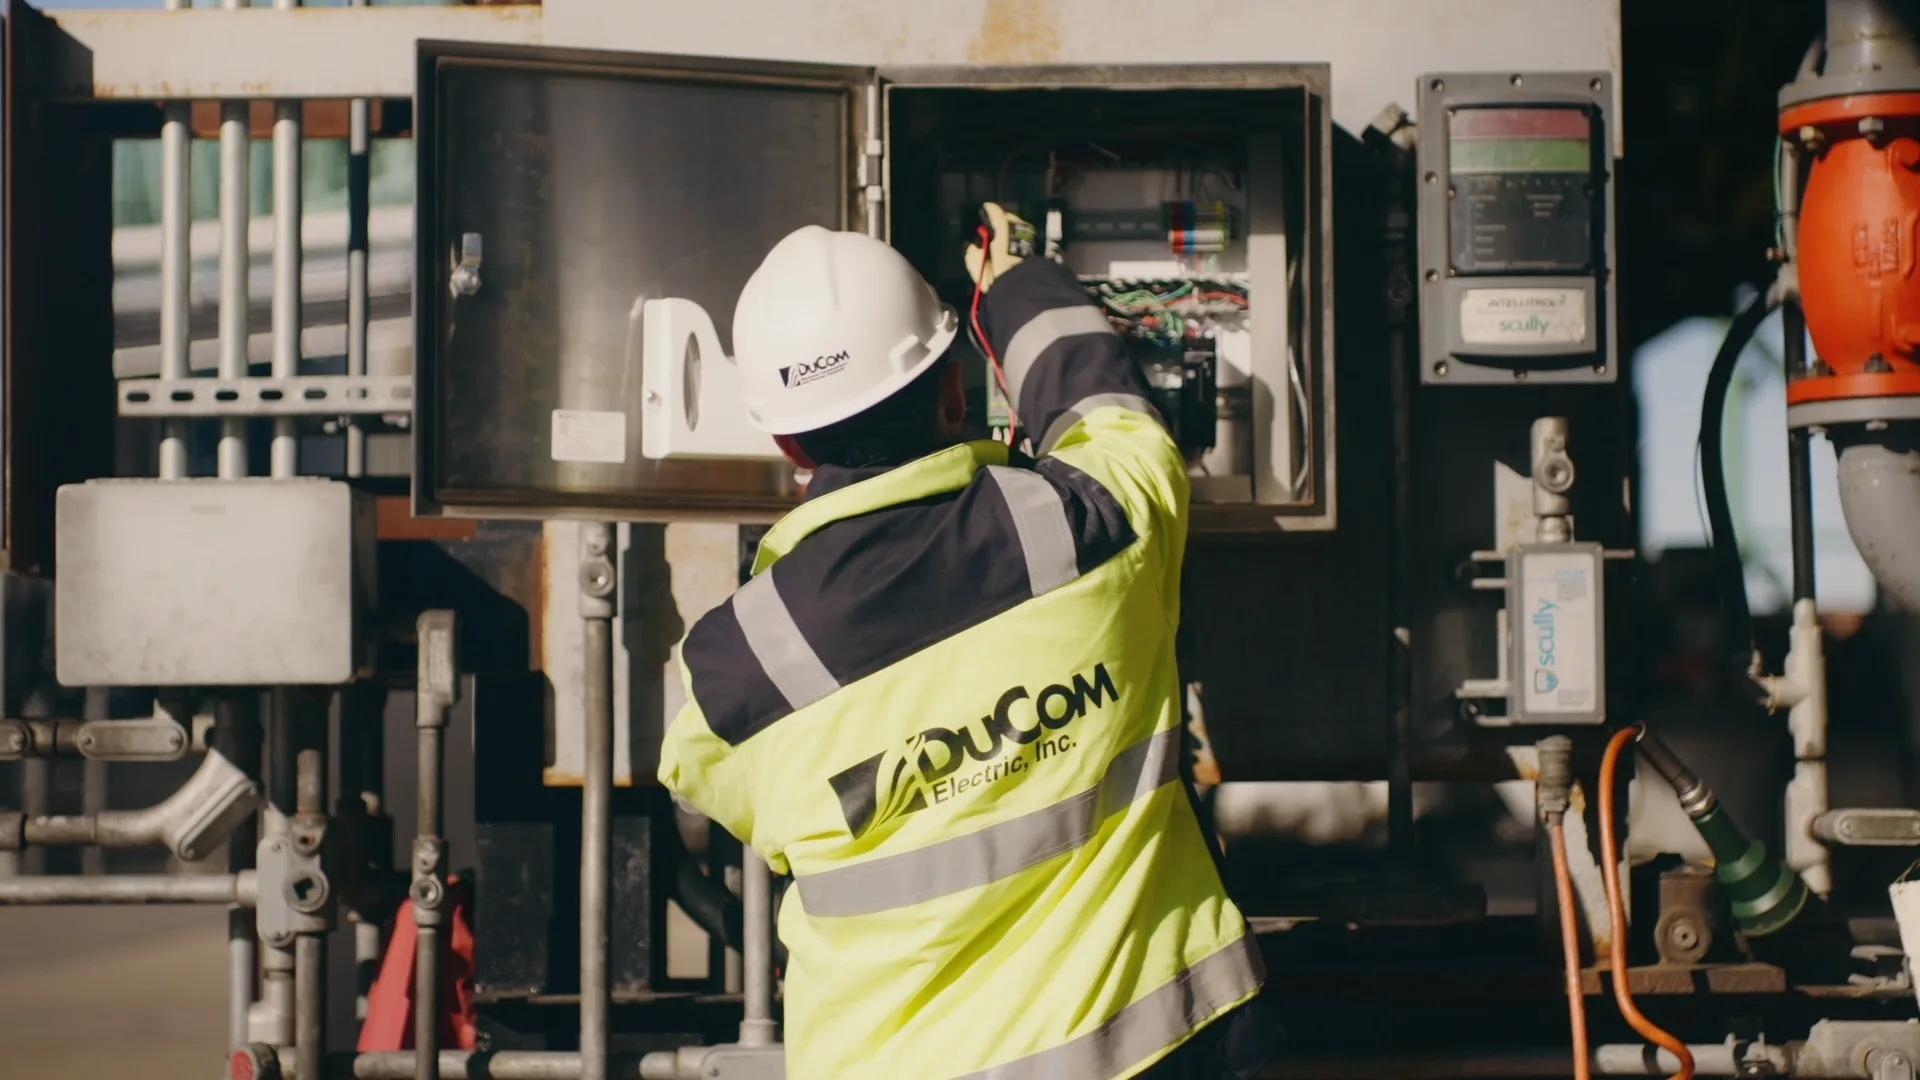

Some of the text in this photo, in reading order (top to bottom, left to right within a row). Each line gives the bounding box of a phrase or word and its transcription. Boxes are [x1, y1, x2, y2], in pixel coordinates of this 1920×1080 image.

[1499, 315, 1550, 335] scully
[1532, 598, 1560, 667] scully
[932, 733, 1078, 805] Electric, Inc.
